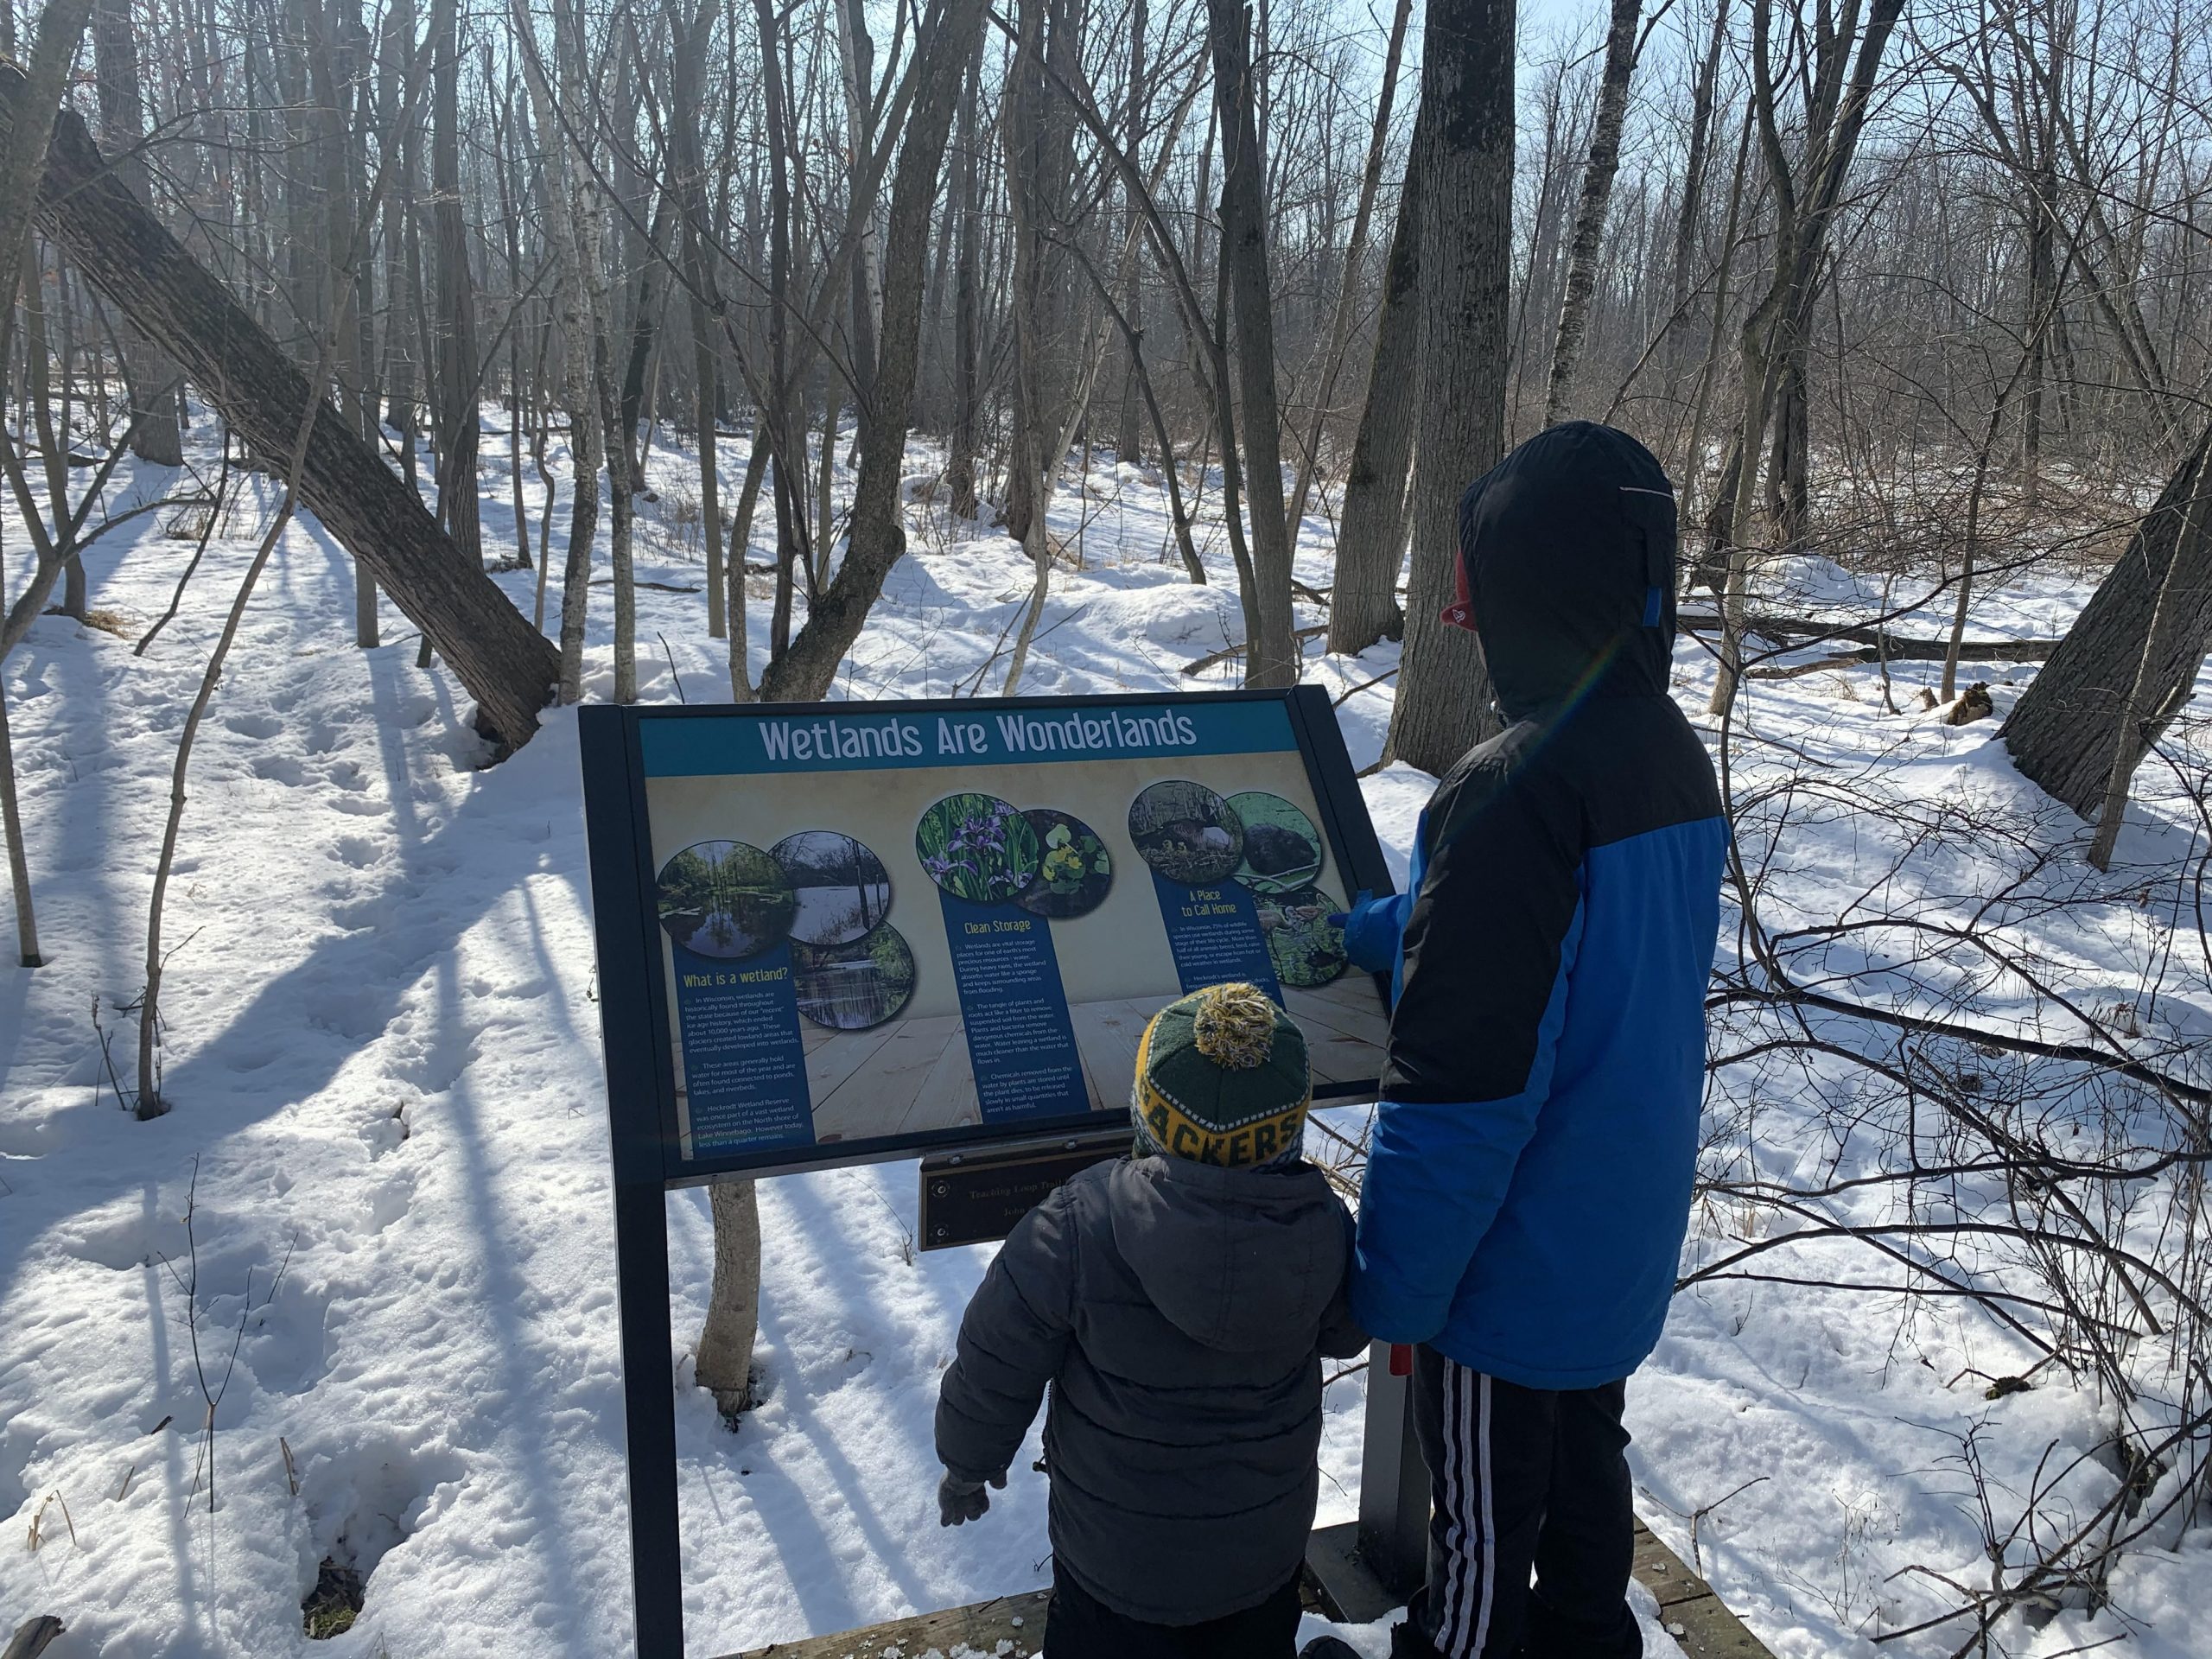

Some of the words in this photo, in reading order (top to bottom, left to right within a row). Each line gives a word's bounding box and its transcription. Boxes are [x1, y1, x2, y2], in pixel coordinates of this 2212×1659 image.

[758, 717, 923, 760] Wetlands
[938, 715, 988, 755] Are
[995, 709, 1198, 753] Wonderlands
[1189, 890, 1197, 902] A
[1197, 889, 1221, 901] Place
[1181, 906, 1192, 917] to
[1194, 904, 1210, 916] Call
[1211, 902, 1236, 914] Home
[964, 921, 991, 934] Clean
[994, 919, 1032, 932] Storage
[683, 974, 712, 988] What
[715, 972, 726, 985] is
[729, 973, 736, 984] a
[740, 967, 788, 982] wetland?
[1014, 1184, 1038, 1193] Loop
